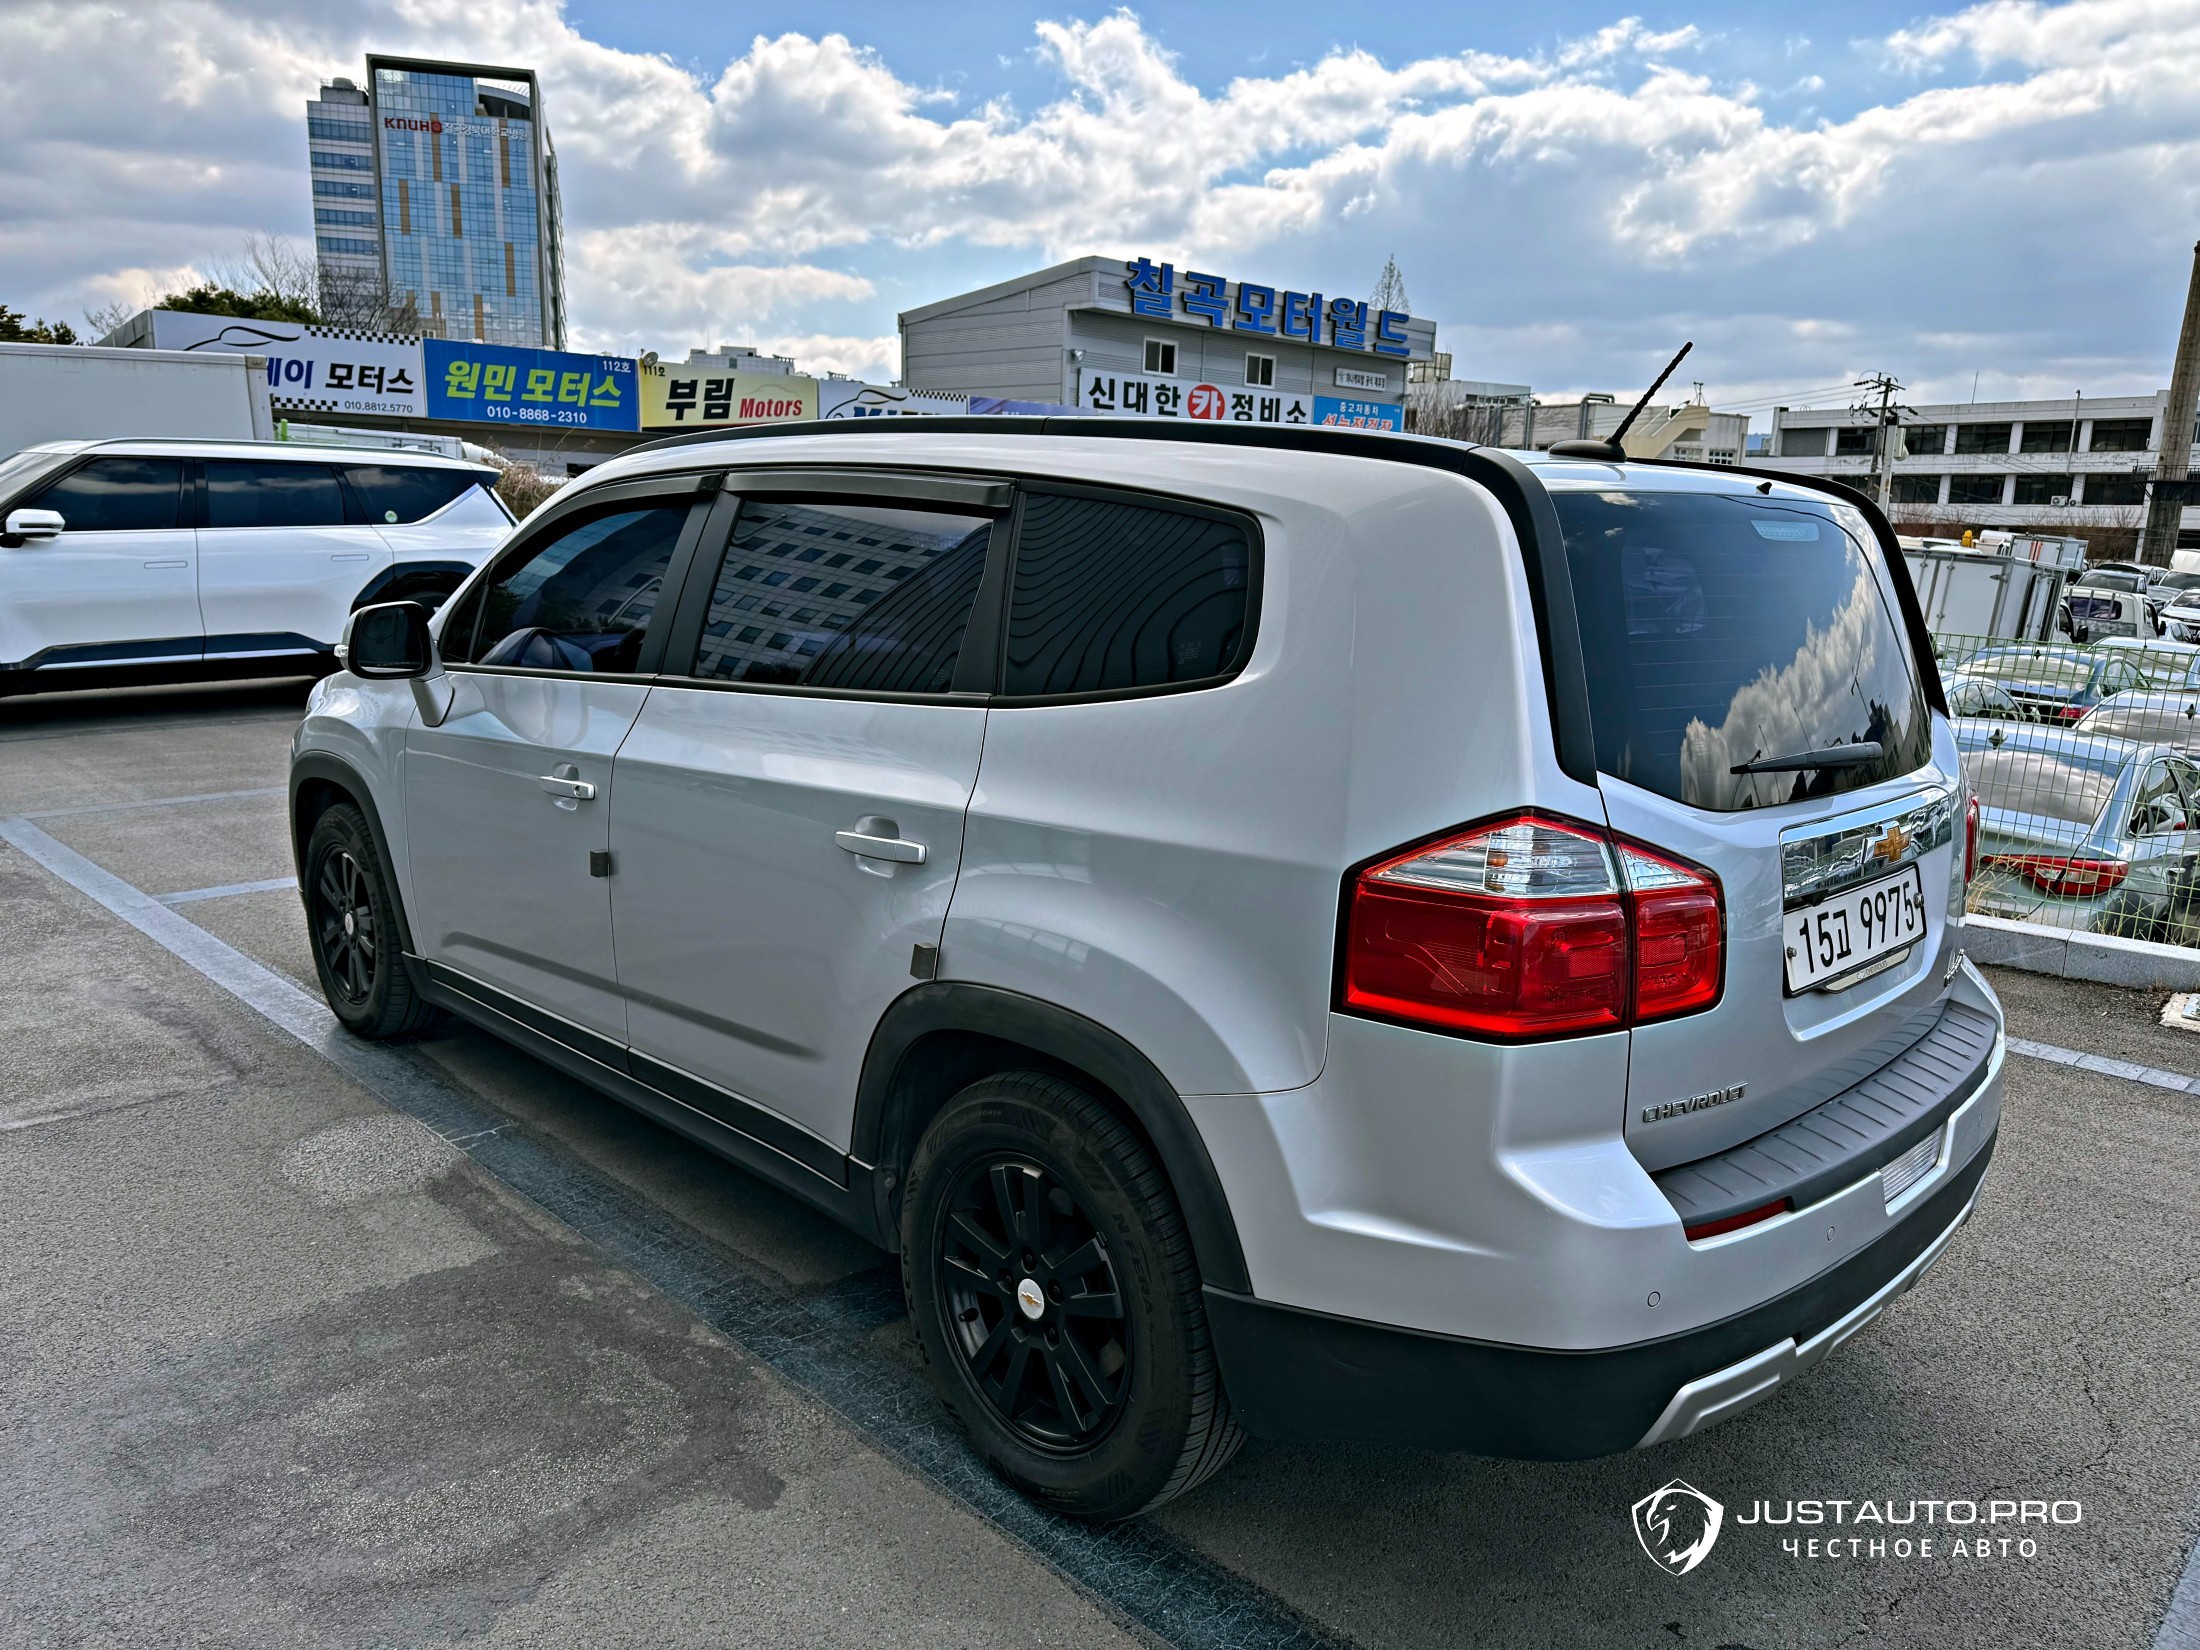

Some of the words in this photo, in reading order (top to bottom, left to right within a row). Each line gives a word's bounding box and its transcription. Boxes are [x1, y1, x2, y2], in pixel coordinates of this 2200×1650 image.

[325, 363, 414, 394] 모터스
[602, 360, 631, 374] 112호
[643, 365, 666, 378] 111호
[444, 361, 517, 401] 원민
[521, 368, 622, 407] 모터스
[344, 401, 413, 413] 010.8812.5770
[665, 377, 735, 421] 부림
[739, 398, 803, 419] Motors
[1088, 376, 1182, 418] 신대한
[1192, 390, 1221, 420] 카
[1231, 392, 1308, 425] 정비소
[487, 406, 587, 424] 010-8868-2310
[1860, 880, 1914, 949] 9975
[1865, 959, 1888, 976] CHEVROLET
[1643, 1081, 1748, 1123] CHEVROLET
